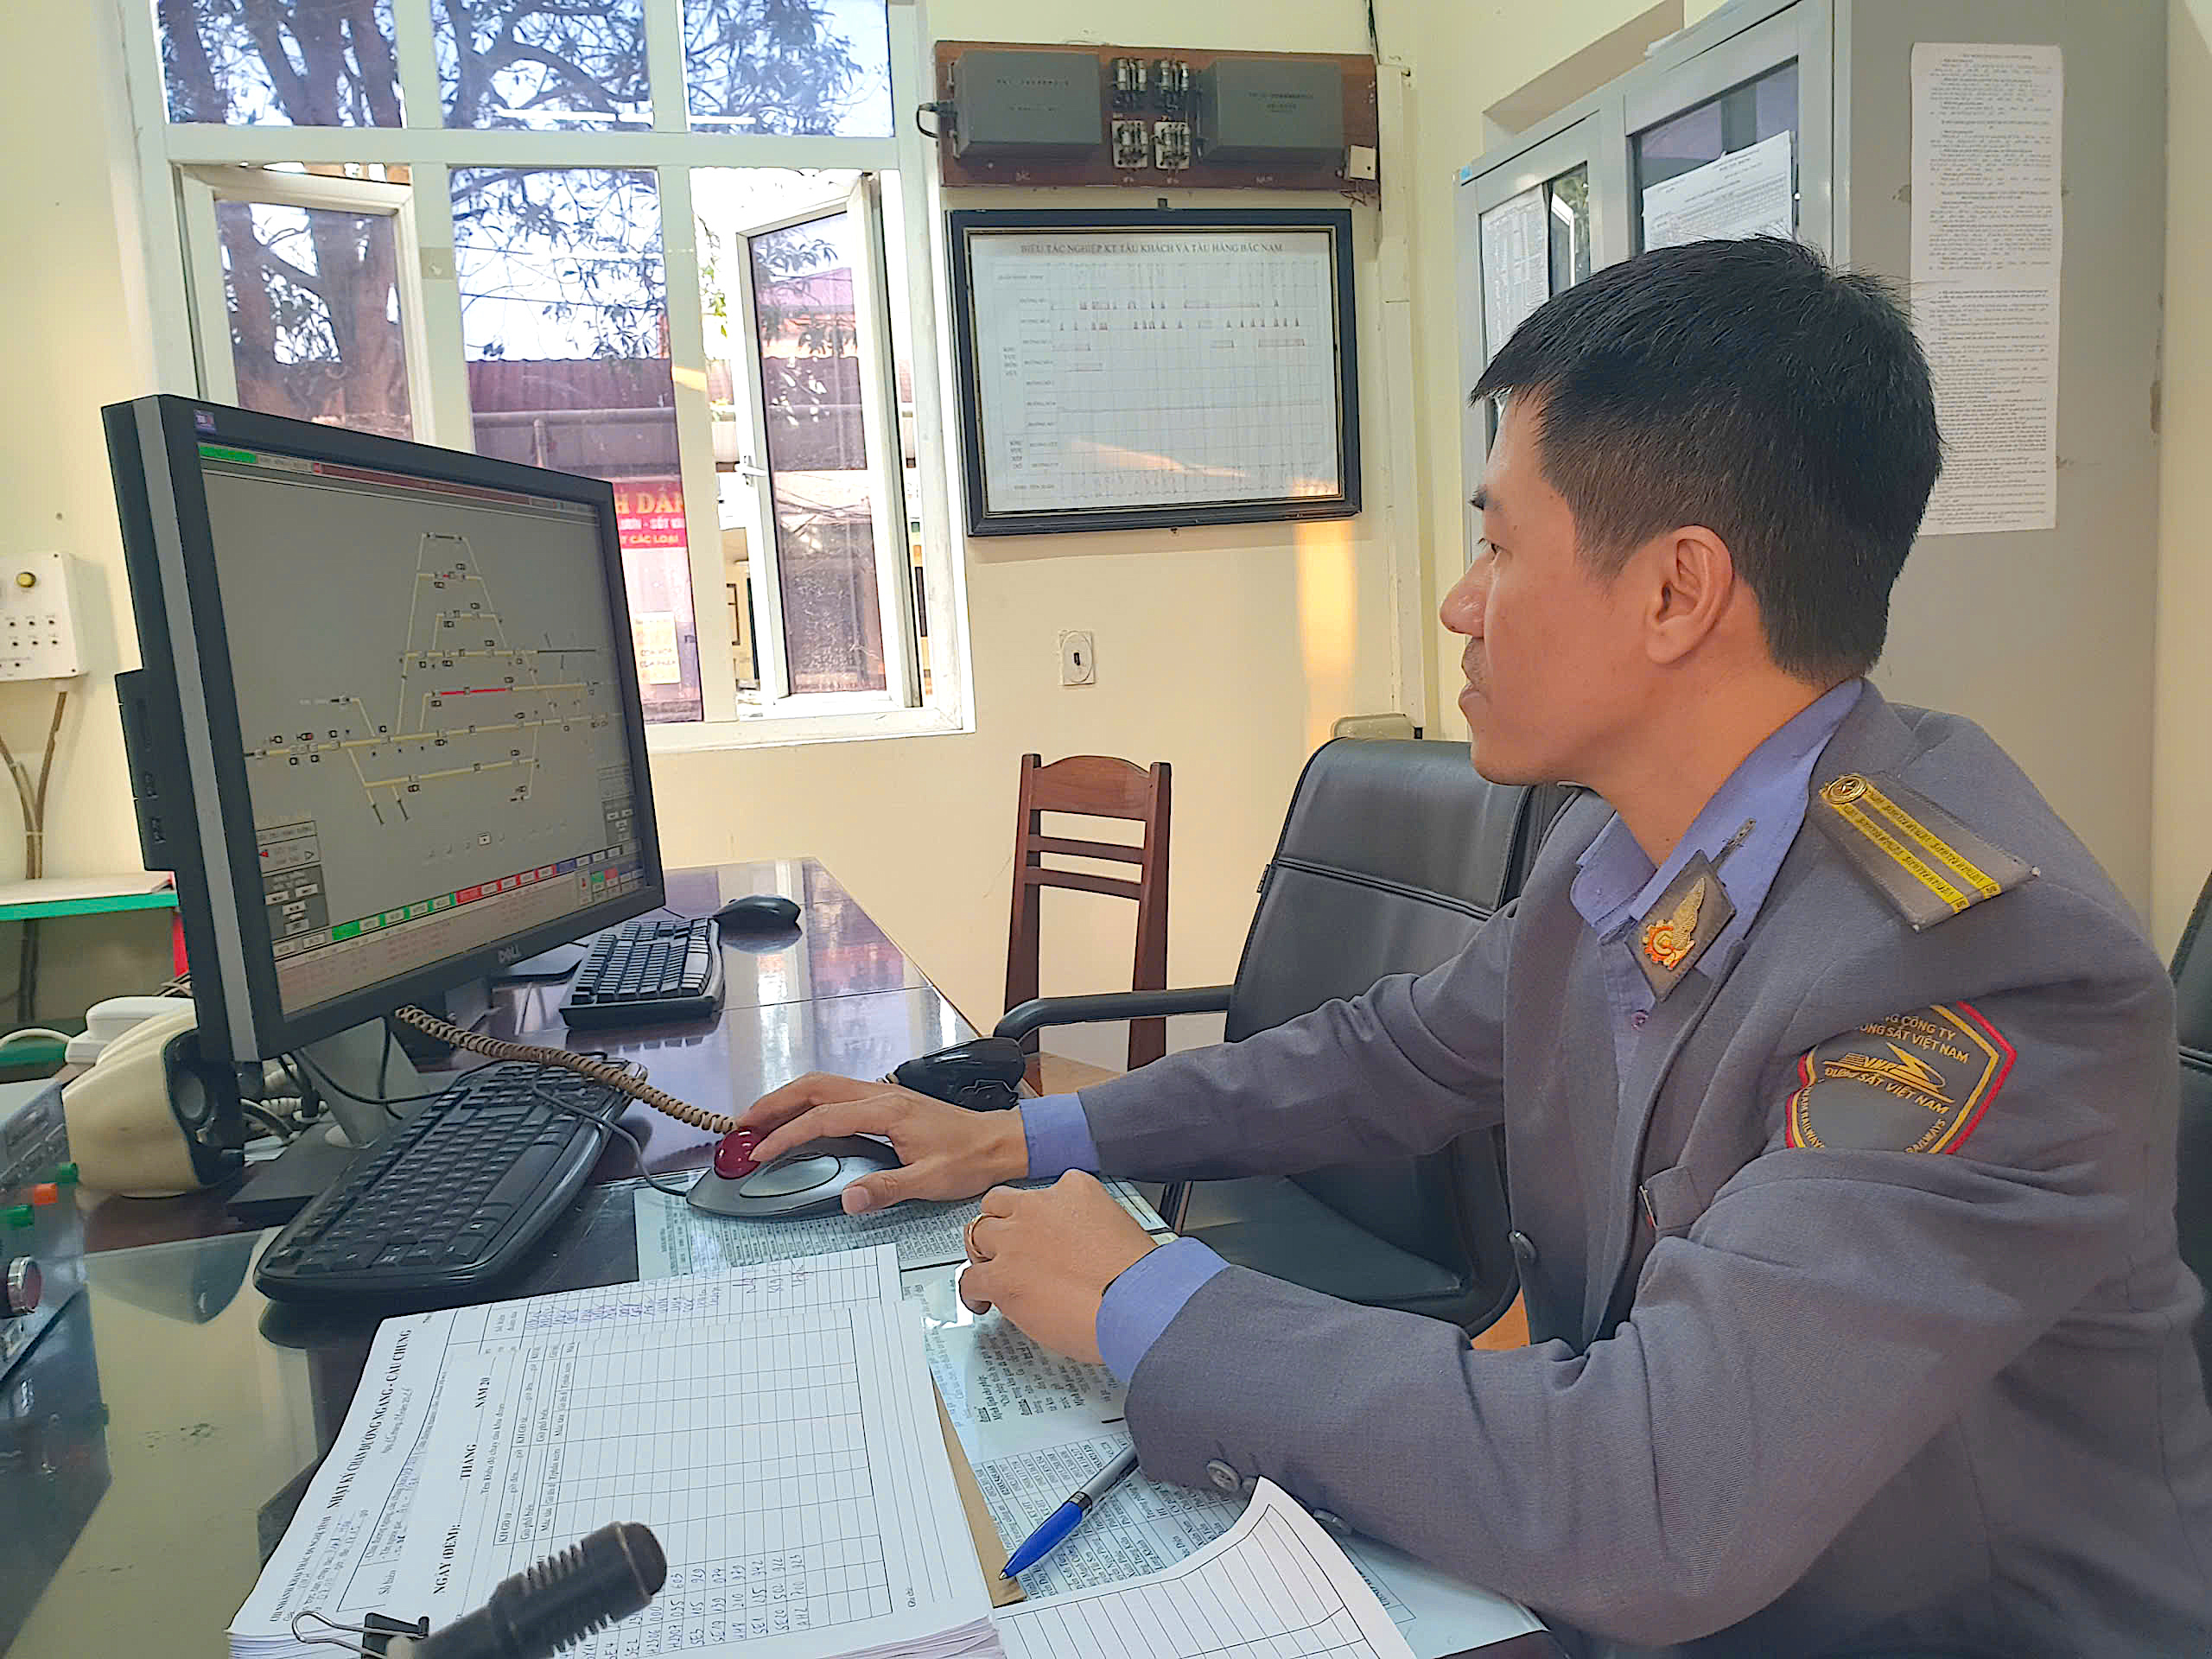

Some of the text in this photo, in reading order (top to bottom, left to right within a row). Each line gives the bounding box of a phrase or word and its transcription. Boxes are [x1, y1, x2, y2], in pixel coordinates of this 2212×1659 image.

[1902, 1014, 1936, 1034] CÔNG
[1939, 1027, 1956, 1041] TY
[1939, 1042, 1970, 1065] NAM
[1915, 1094, 1950, 1115] NAM
[371, 1389, 394, 1421] NGANG
[391, 1330, 412, 1361] CHUNG
[432, 1562, 452, 1595] NGÀY
[458, 1444, 478, 1480] THÁNG
[472, 1387, 489, 1409] NĂM
